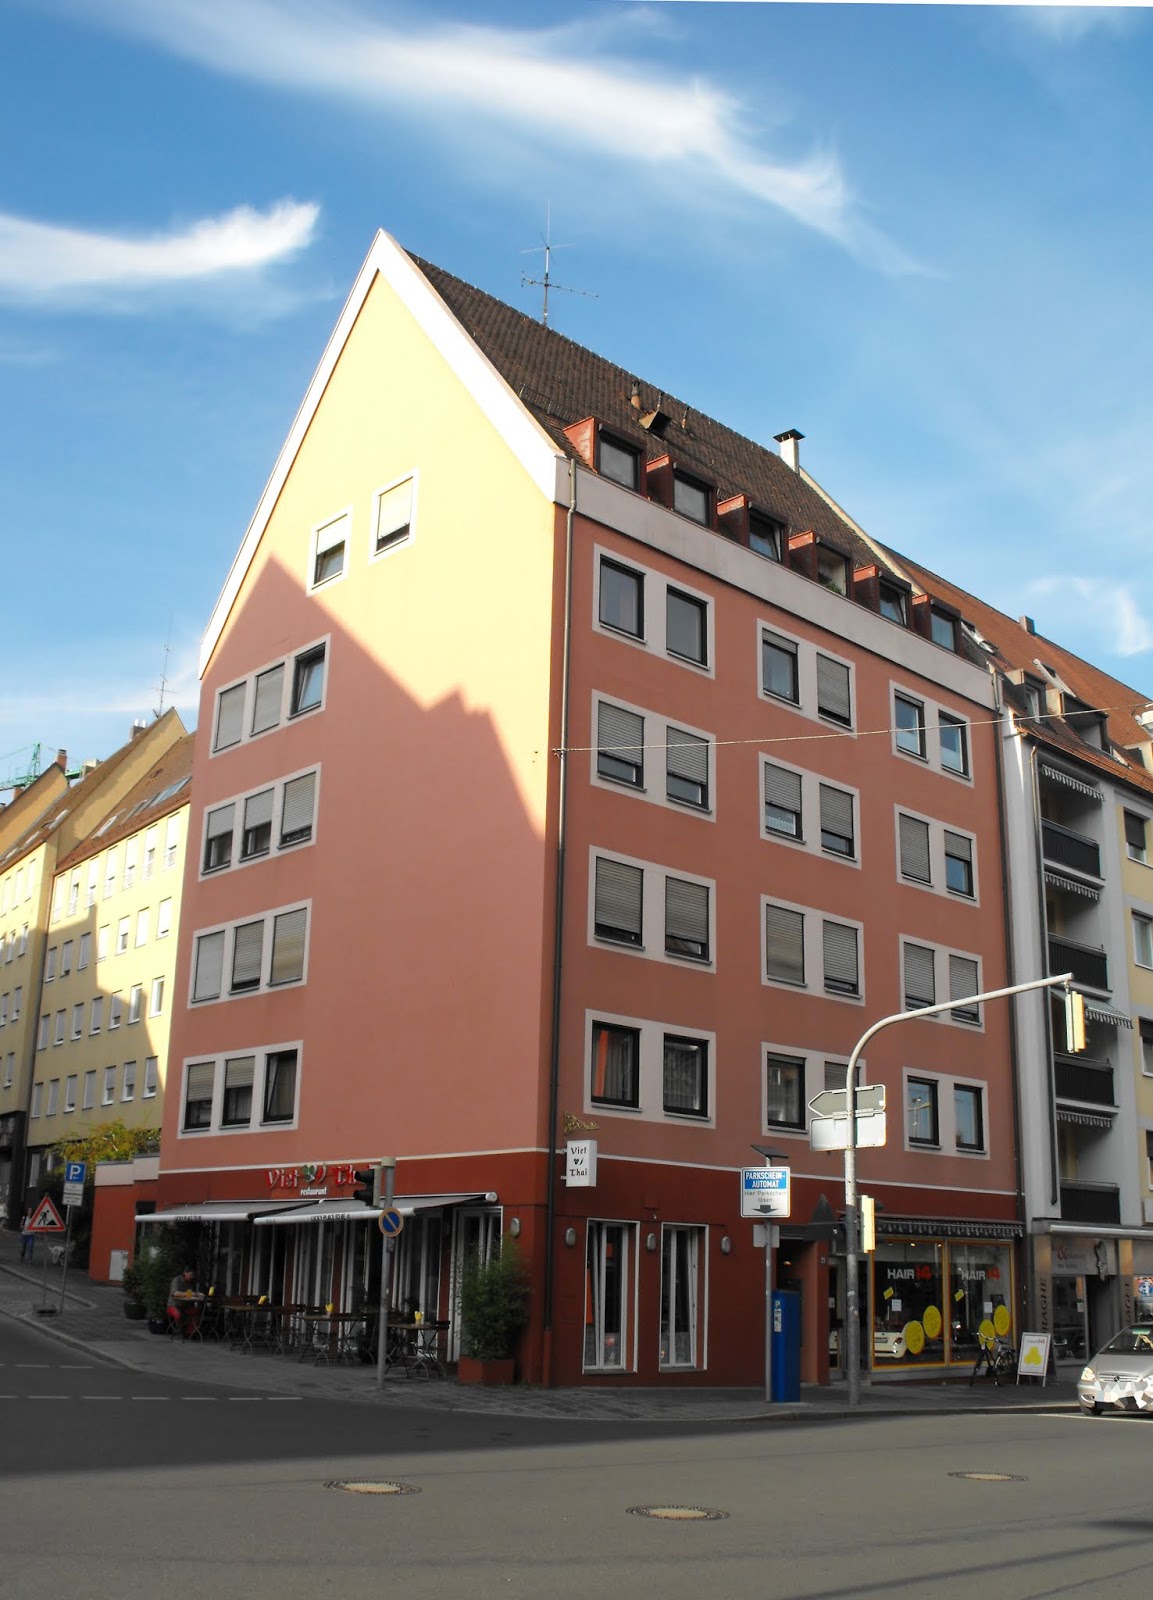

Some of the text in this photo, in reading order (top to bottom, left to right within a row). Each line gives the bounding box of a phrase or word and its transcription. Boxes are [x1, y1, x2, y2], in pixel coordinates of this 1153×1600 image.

[70, 1165, 81, 1180] P
[569, 1168, 588, 1176] Thai
[745, 1172, 786, 1180] PARKSCHEIN-
[266, 1168, 300, 1190] Viet
[752, 1180, 779, 1188] AUTOMAT
[887, 1269, 915, 1279] HAIR
[961, 1270, 986, 1280] HAIR
